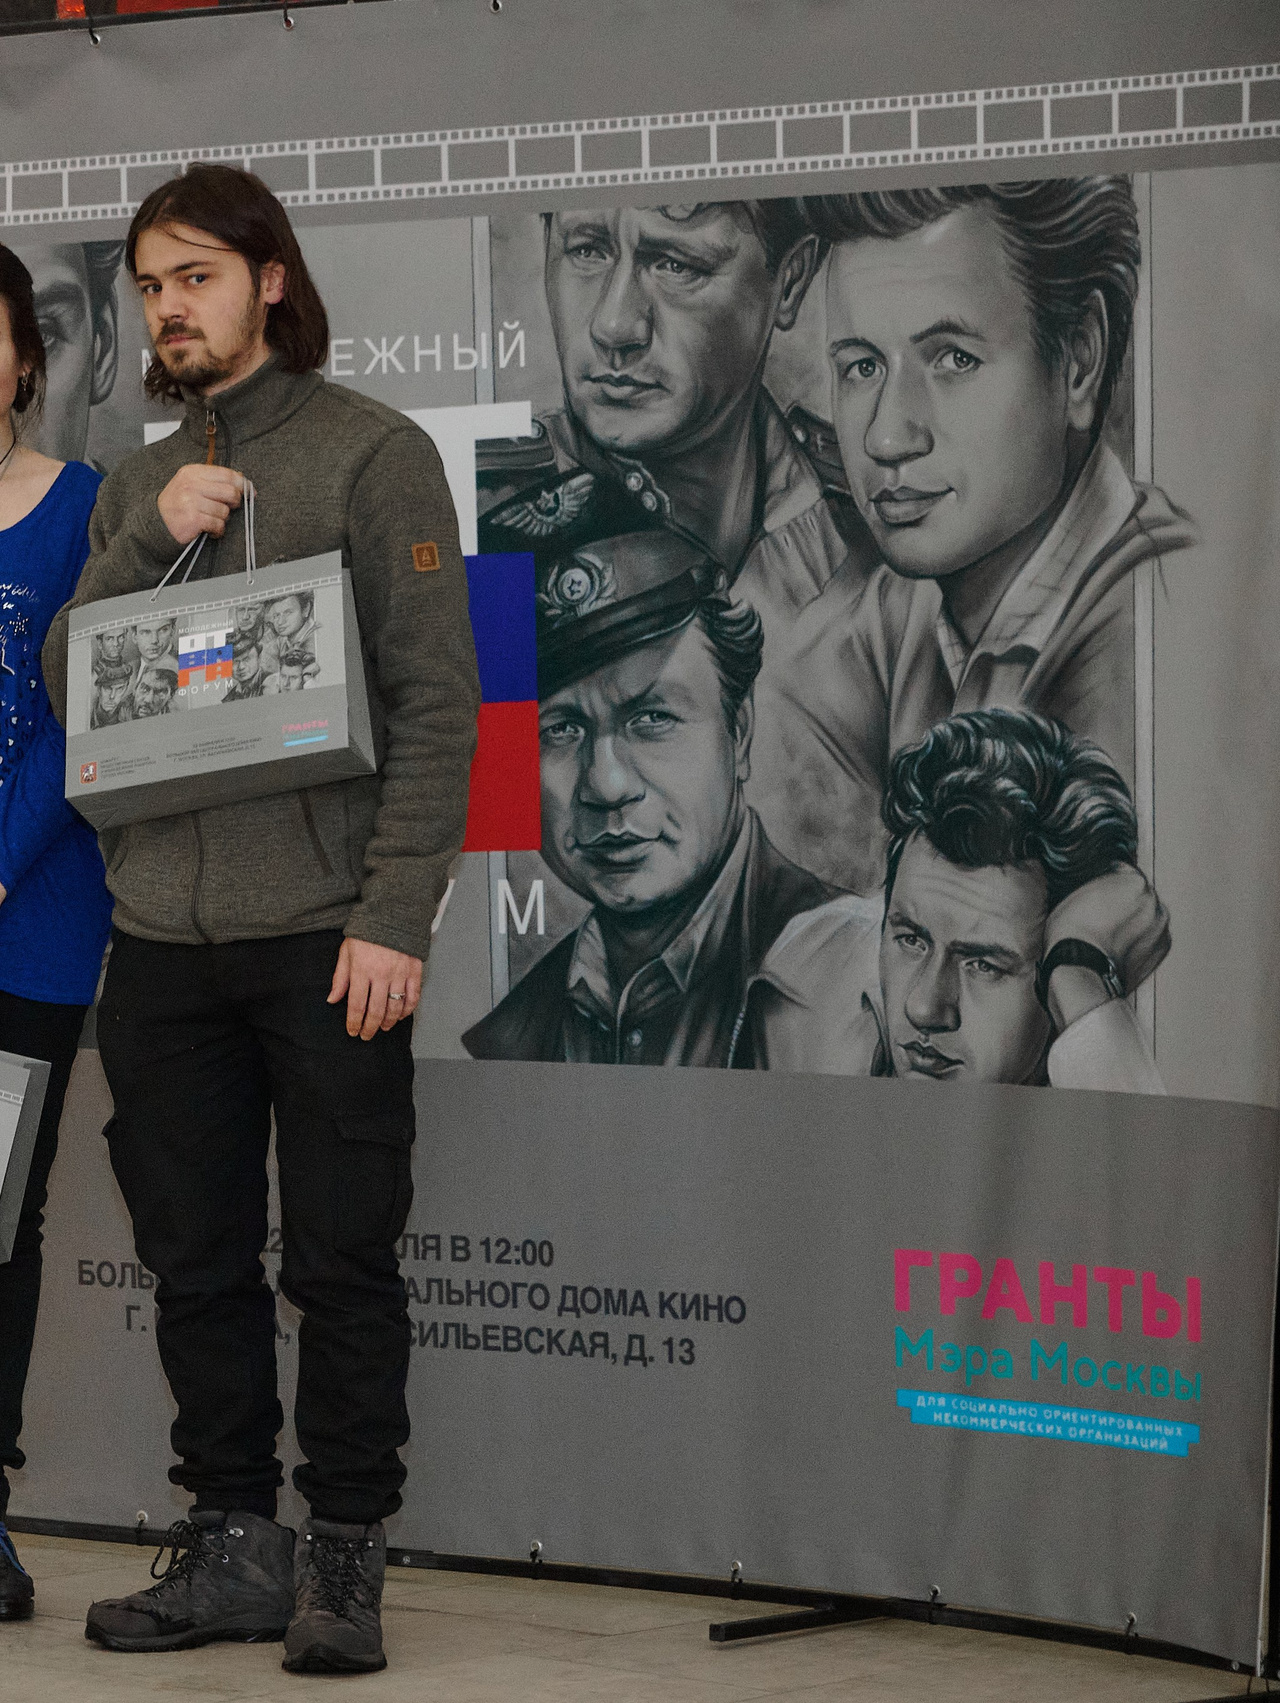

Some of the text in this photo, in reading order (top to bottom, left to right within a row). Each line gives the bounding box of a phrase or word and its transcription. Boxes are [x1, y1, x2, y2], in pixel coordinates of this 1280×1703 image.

[330, 321, 526, 376] ЕЖНЫЙ
[179, 620, 233, 634] МОЛОДЕЖНЫЙ
[179, 679, 233, 696] ФОРУМ
[451, 1235, 470, 1262] В
[479, 1237, 554, 1268] 12:00
[78, 1259, 746, 1324] БОЛЬ АЛЬНОГО ДОМА КИНО
[894, 1249, 1201, 1342] ГРАНТЫ
[126, 1305, 695, 1367] Г. СИЛЬЕВСКАЯ, Д. 13
[895, 1326, 1201, 1401] Мэра Москвы
[916, 1396, 1182, 1437] ДЛЯ СОЦИАЛЬНО ОРИЕНТИРОВАННЫХ
[934, 1412, 1169, 1451] НЕКОММЕРЧЕСКИХ ОРГАНИЗАЦИЙ
